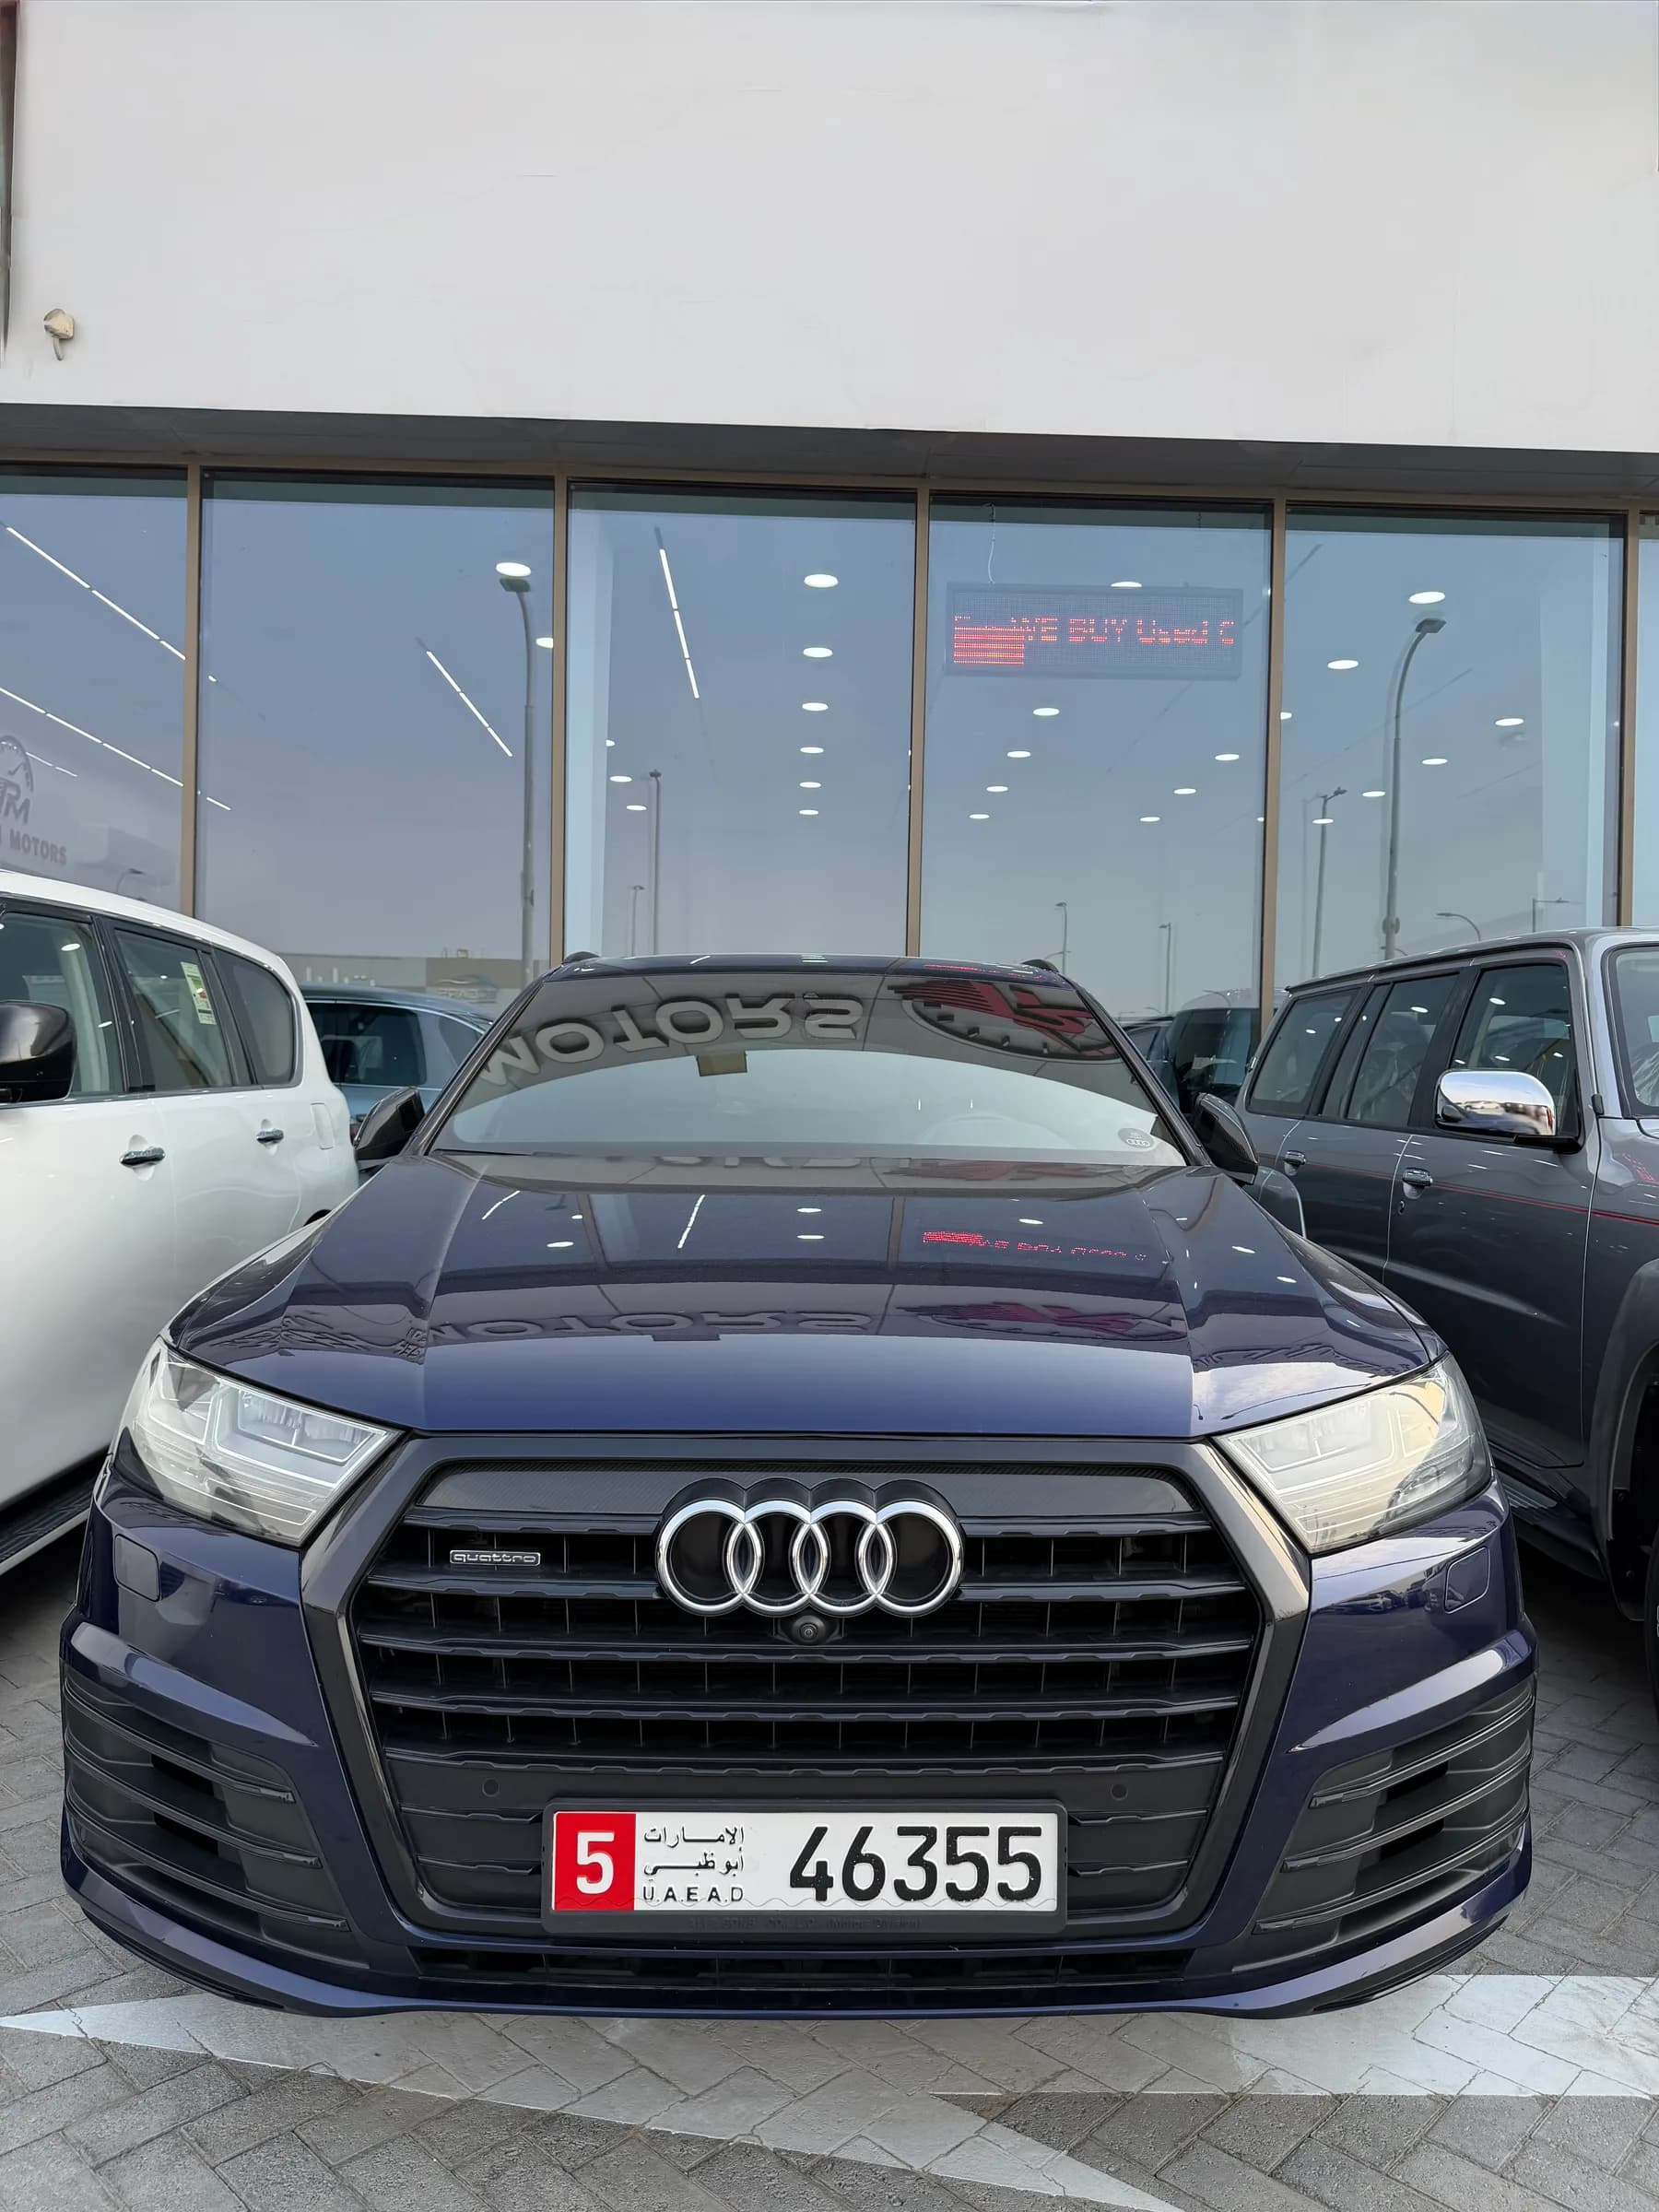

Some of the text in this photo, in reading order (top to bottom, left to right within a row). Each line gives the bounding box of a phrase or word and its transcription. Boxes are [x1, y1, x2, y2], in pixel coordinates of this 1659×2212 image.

[1068, 618, 1127, 642] BUY
[9, 828, 67, 865] MOTORS
[453, 1552, 536, 1563] quattro
[576, 1830, 615, 1895] 5
[790, 1826, 1042, 1901] 46355
